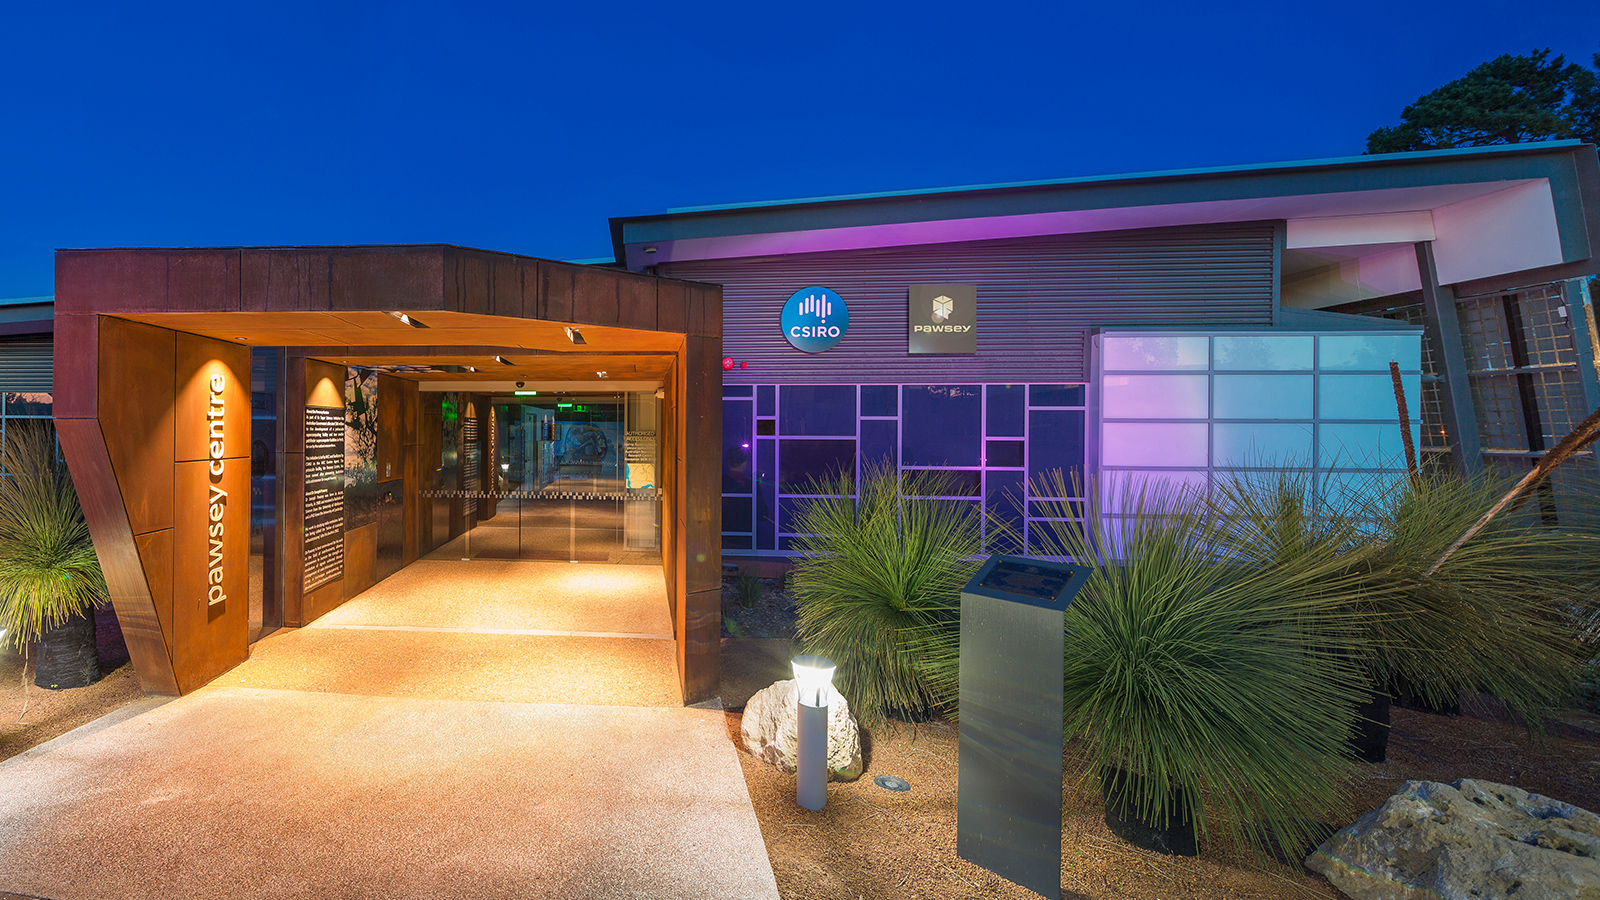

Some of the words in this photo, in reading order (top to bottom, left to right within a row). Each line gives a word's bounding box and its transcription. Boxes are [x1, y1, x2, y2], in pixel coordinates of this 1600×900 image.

[790, 326, 840, 338] CSIRO
[207, 373, 225, 476] centre
[208, 485, 228, 606] pawsey
